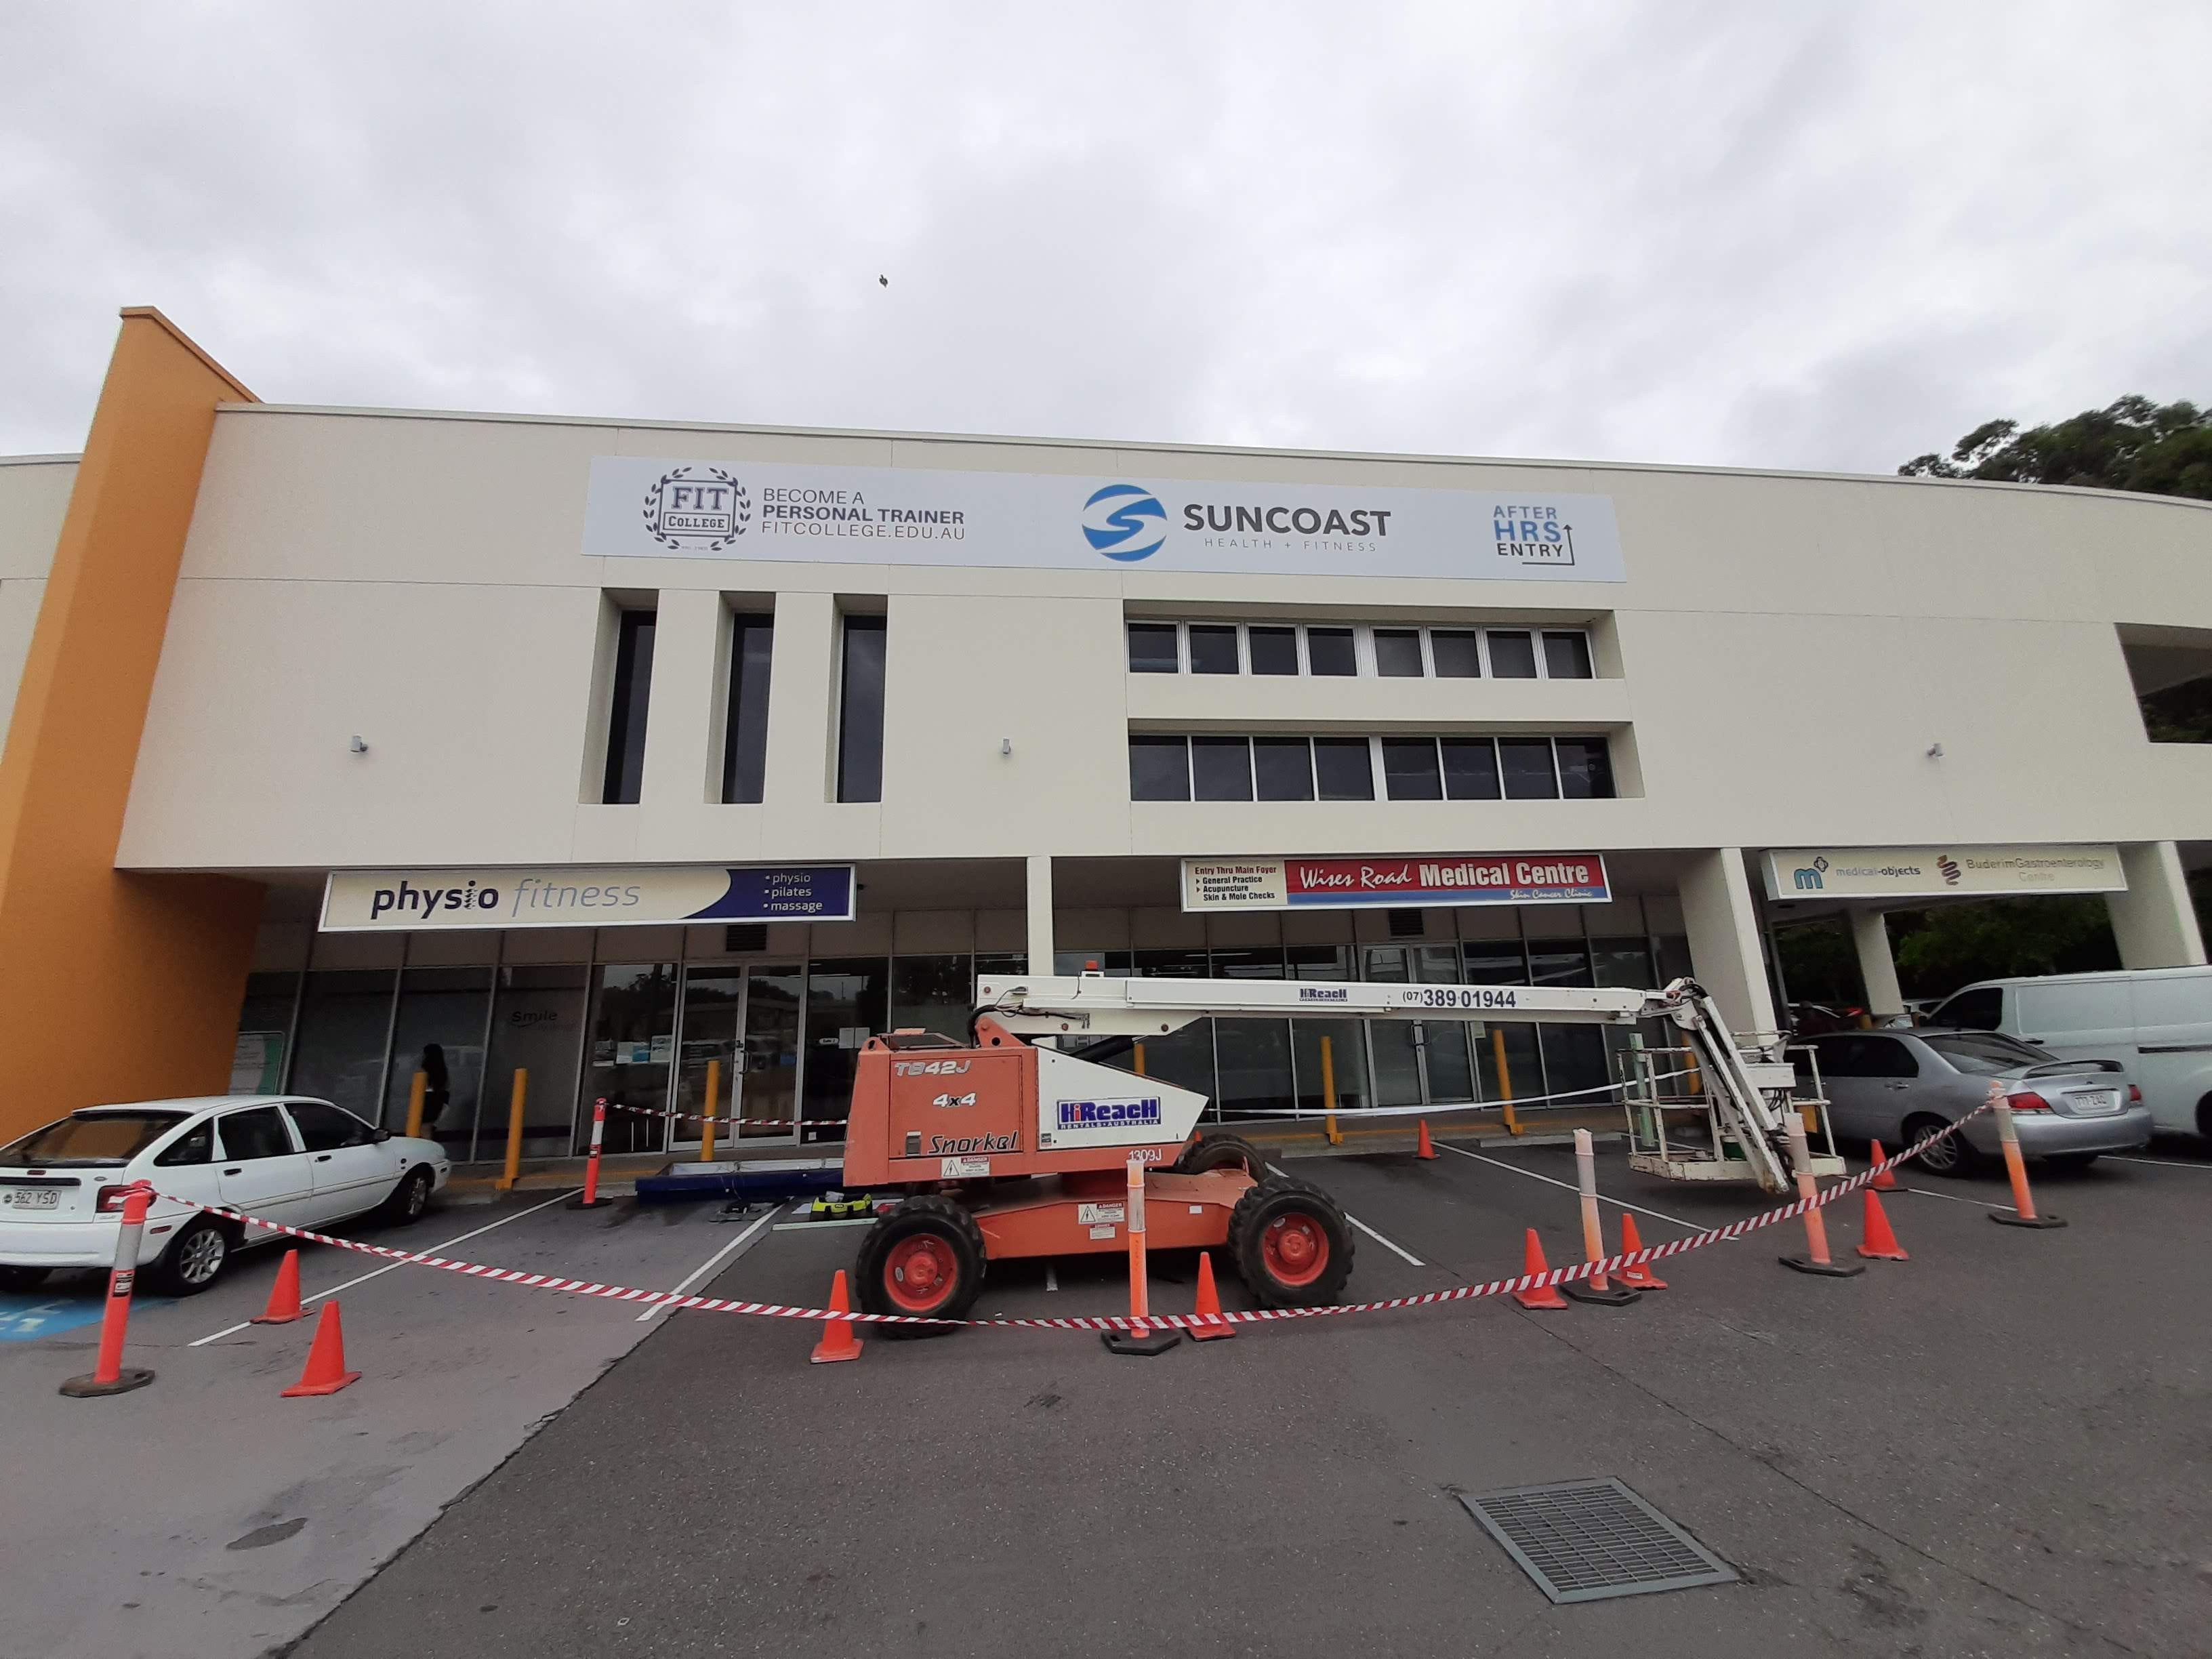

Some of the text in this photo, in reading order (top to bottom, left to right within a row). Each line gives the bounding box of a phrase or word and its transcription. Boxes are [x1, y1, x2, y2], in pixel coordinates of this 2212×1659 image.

[672, 487, 729, 511] FIT
[763, 488, 865, 505] BECOME A
[762, 504, 965, 525] PERSONAL TRAINER
[1493, 505, 1557, 519] AFTER
[668, 515, 725, 531] COLLEGE
[1183, 504, 1391, 537] SUNCOAST
[762, 521, 965, 540] FITCOLLEGE.EDU.AU
[1494, 520, 1561, 543] HRS
[1205, 538, 1272, 550] HEALTH
[1304, 541, 1378, 552] FITNESS
[1497, 543, 1563, 556] ENTRY
[1195, 867, 1214, 875] Entry
[1216, 866, 1233, 874] Thru
[1256, 866, 1276, 874] Foyer
[1360, 864, 1412, 888] Road
[1419, 863, 1510, 887] Medical
[1516, 862, 1589, 884] Centre
[773, 872, 811, 885] physio
[1203, 876, 1231, 884] General
[771, 886, 812, 899] pilates
[1203, 884, 1249, 893] Acupuncture
[1510, 889, 1530, 900] Skin
[371, 879, 640, 920] physio fitness
[771, 902, 823, 913] massage
[512, 1010, 558, 1022] Smile
[933, 1092, 976, 1108] 4x4
[928, 1130, 1019, 1154] Snorkel
[1128, 1149, 1162, 1161] 1309J
